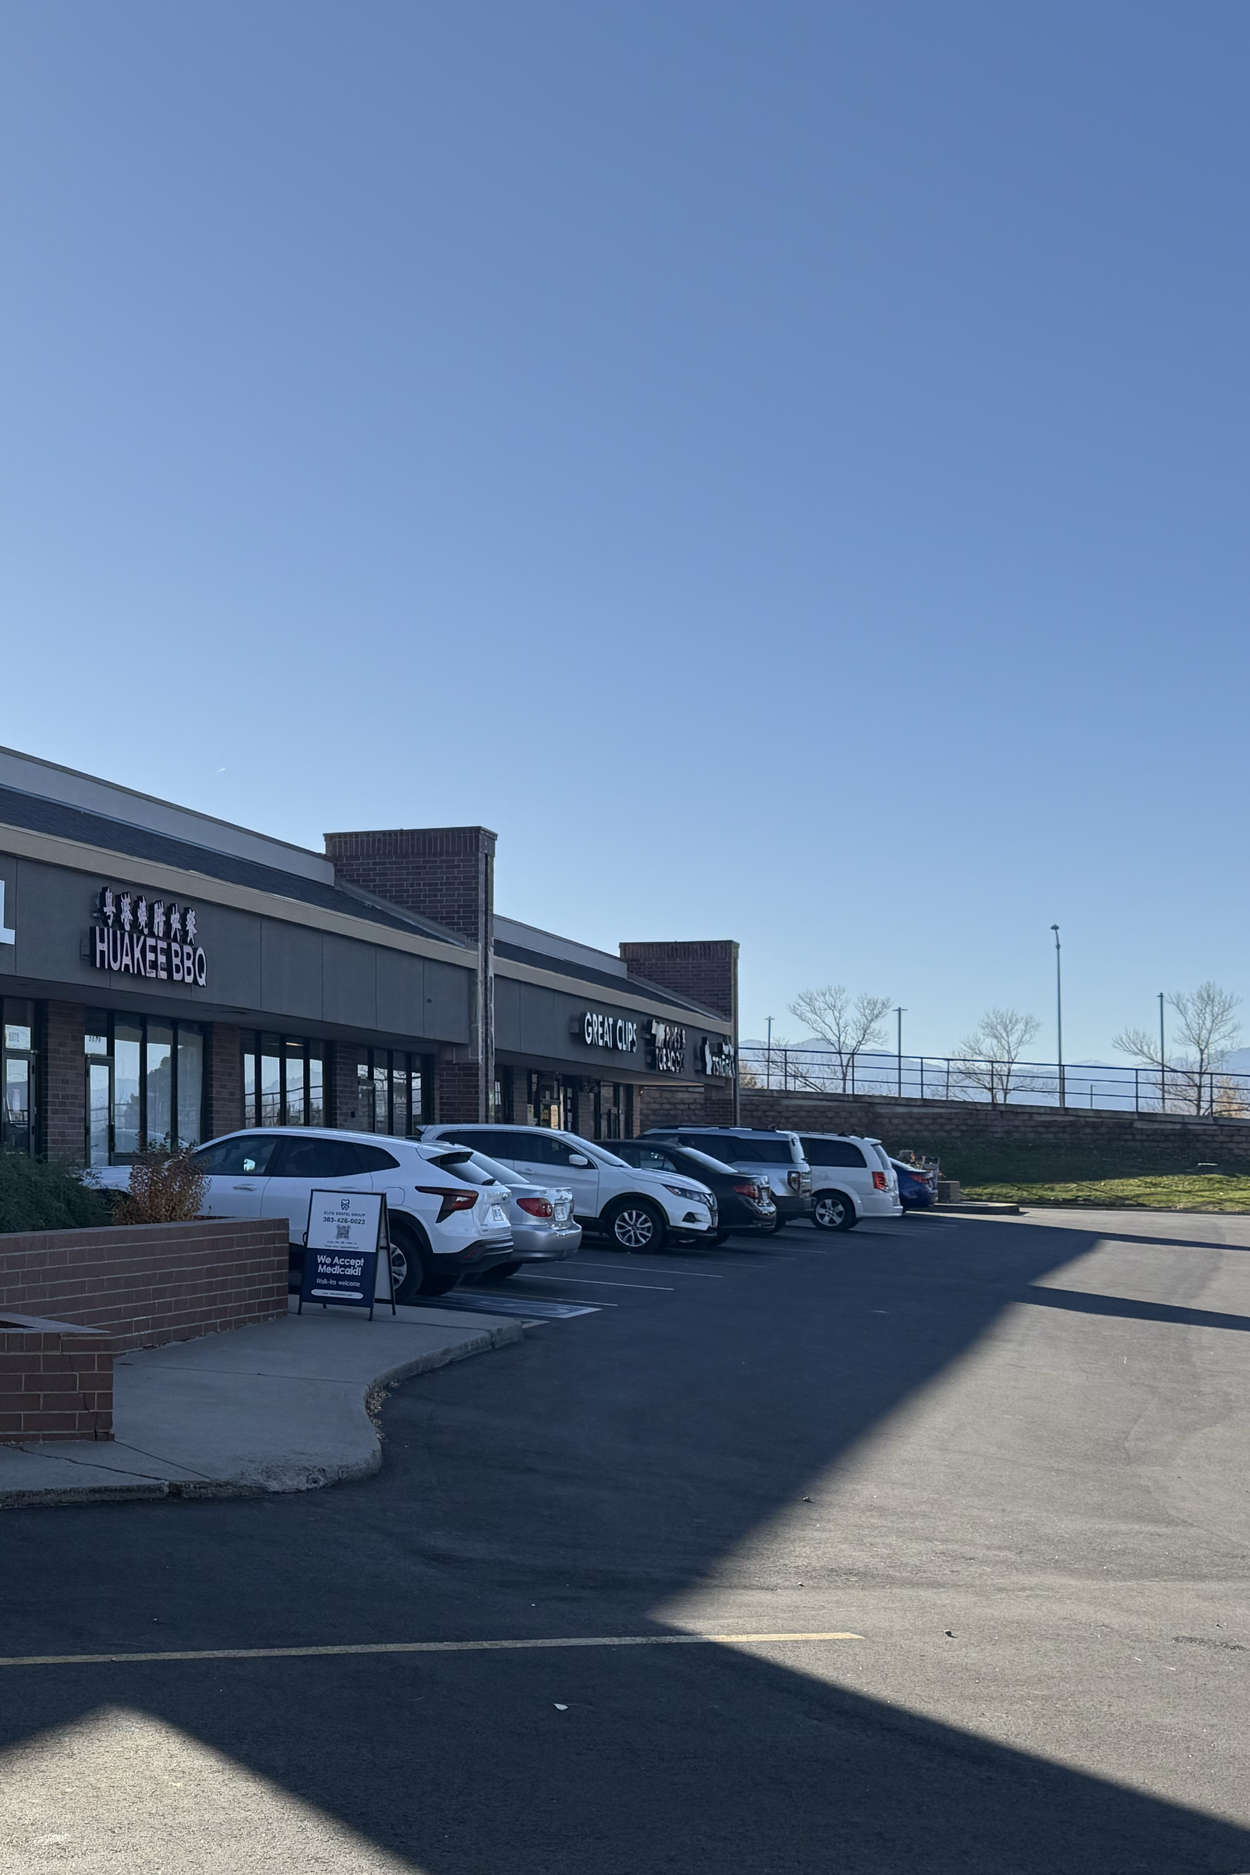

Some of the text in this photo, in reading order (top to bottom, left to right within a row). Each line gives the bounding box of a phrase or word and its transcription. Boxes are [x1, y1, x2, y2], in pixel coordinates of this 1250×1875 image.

[95, 926, 207, 987] HUAKEE BBQ
[584, 1012, 613, 1049] GREAT
[616, 1018, 638, 1053] CLIPS
[317, 1254, 365, 1267] We Accept
[317, 1264, 362, 1276] Medicaid!
[316, 1278, 361, 1288] Walk-ins welcome
